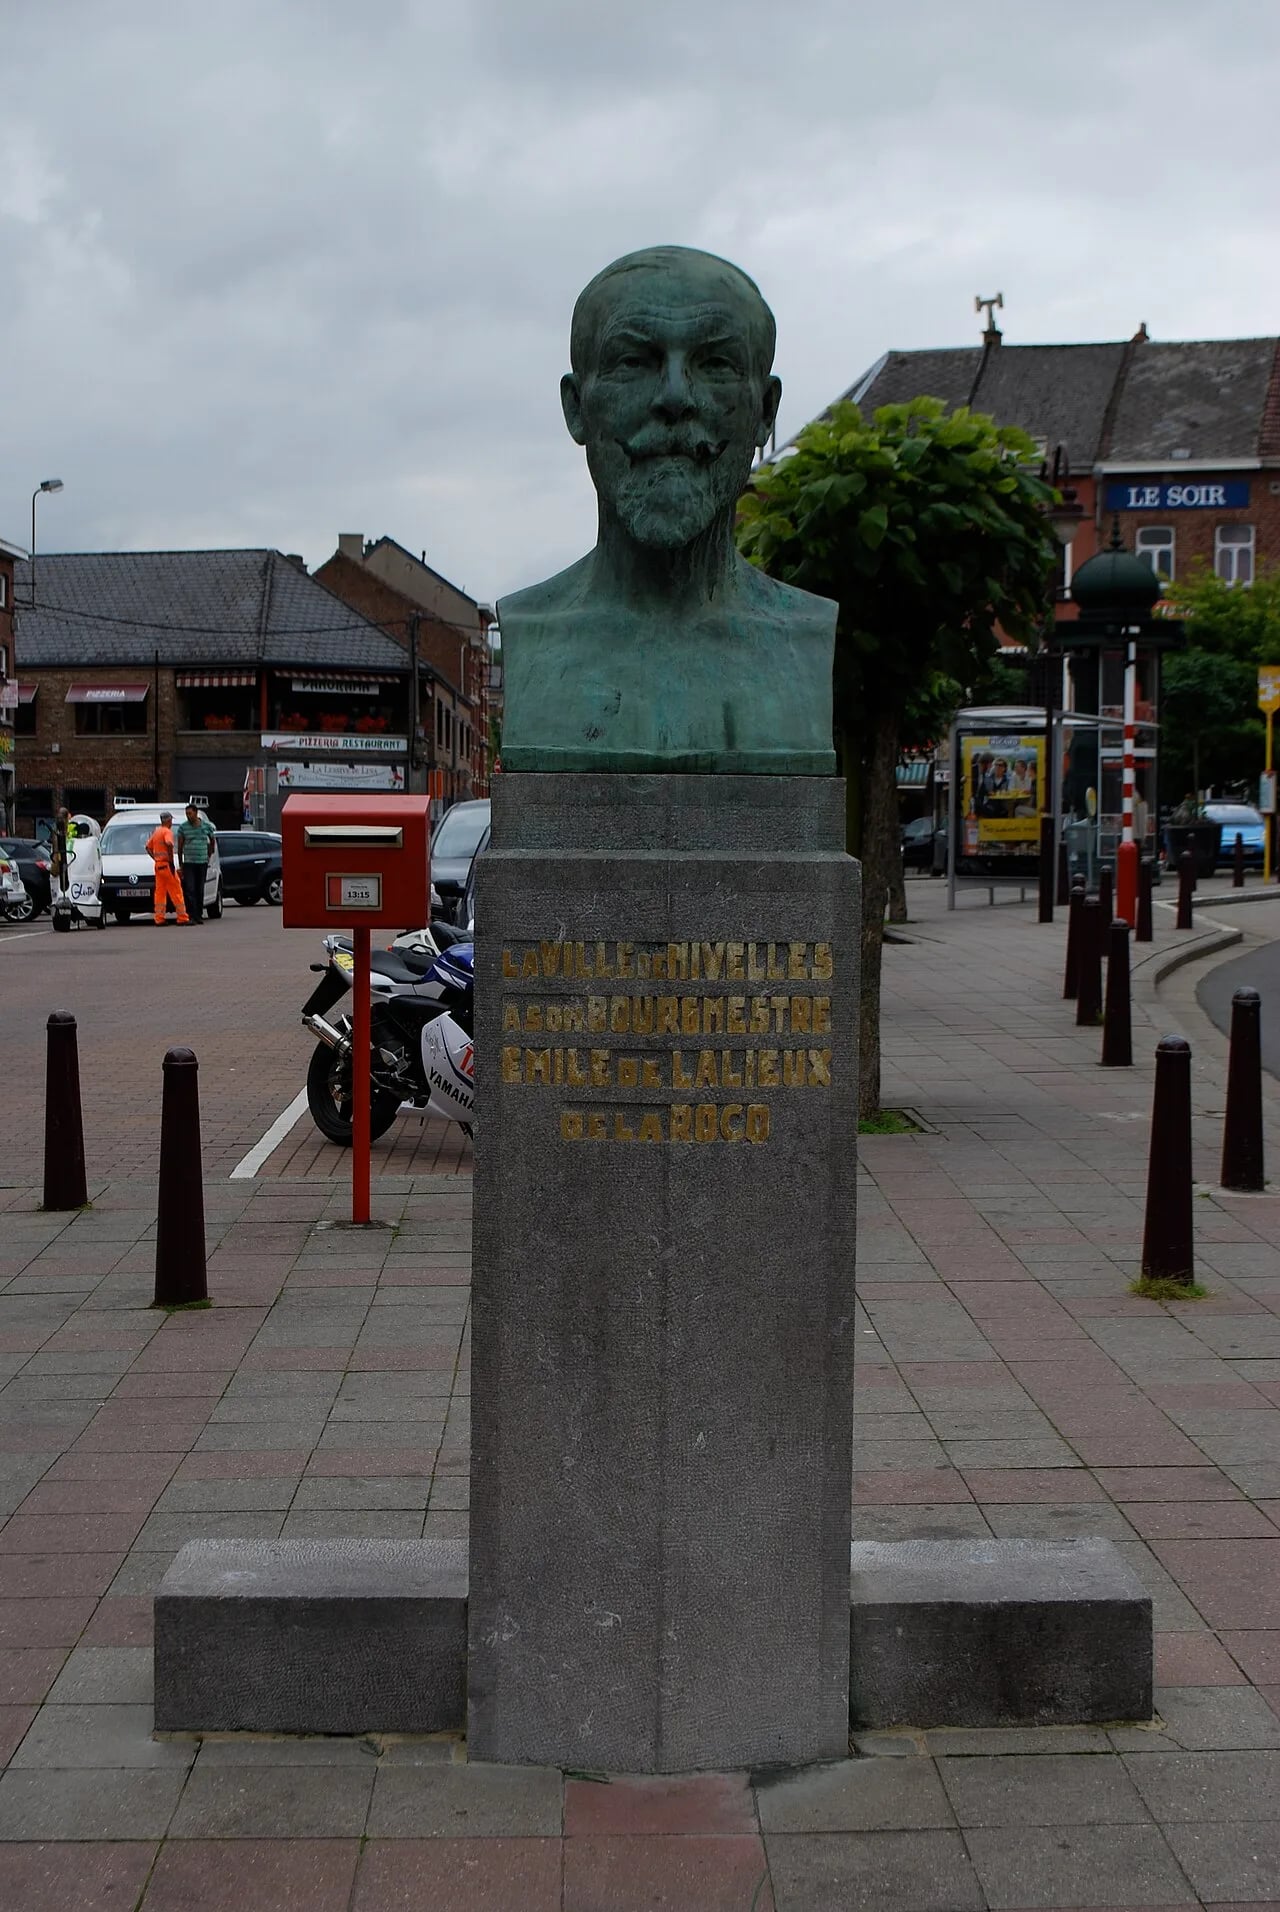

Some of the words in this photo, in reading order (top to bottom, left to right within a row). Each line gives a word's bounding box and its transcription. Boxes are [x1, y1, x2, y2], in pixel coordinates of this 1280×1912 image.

[1127, 486, 1160, 507] LE
[1167, 484, 1227, 506] SOIR
[86, 689, 126, 698] PIZZERIA
[299, 737, 339, 747] PIZZERIA
[342, 738, 402, 749] RESTAURANT
[348, 891, 370, 899] 13:15
[502, 950, 539, 978] LA
[540, 941, 635, 978] VILLE
[637, 953, 667, 980] DE
[667, 942, 833, 981] NIVELLES
[502, 1004, 521, 1032] A
[587, 995, 832, 1035] BOURGMESTRE
[501, 1046, 612, 1087] EMILE
[617, 1057, 663, 1089] DE
[671, 1049, 832, 1089] LALIEUX
[560, 1110, 607, 1140] DE
[614, 1112, 662, 1142] LA
